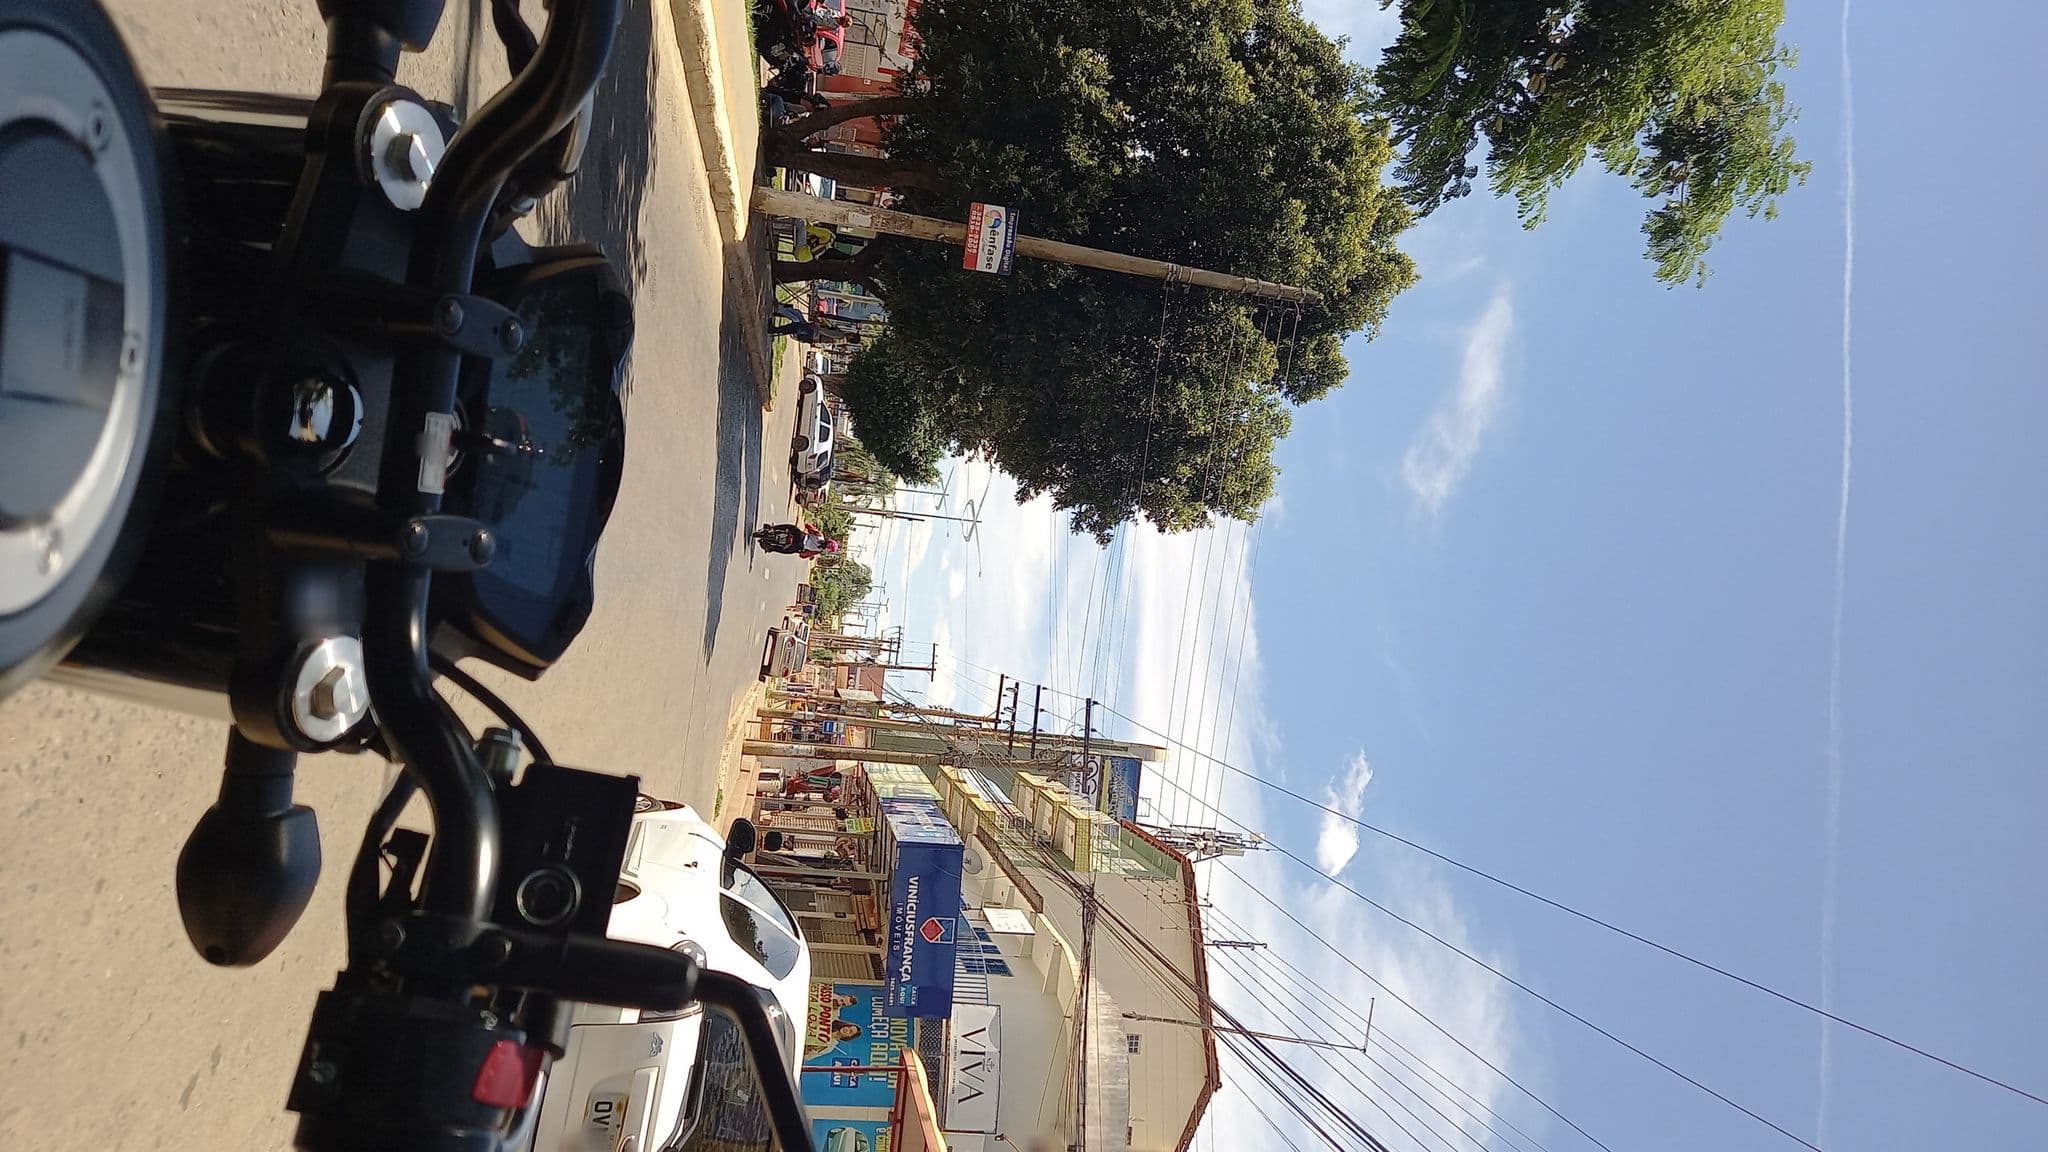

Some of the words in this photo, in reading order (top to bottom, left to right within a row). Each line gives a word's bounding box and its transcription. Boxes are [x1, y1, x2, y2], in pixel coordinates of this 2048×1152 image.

[1006, 212, 1016, 248] Impressão
[985, 229, 1000, 270] ênfase
[1002, 249, 1011, 272] Digital
[892, 902, 904, 951] IMÓVEIS
[899, 876, 920, 982] VINÍCIUSFRANÇA
[808, 1007, 818, 1038] LOJA
[817, 1005, 832, 1044] PONTO
[889, 1018, 908, 1051] NOVA
[833, 1061, 841, 1085] AUI
[958, 1027, 987, 1104] VIVA
[592, 1101, 613, 1129] OV
